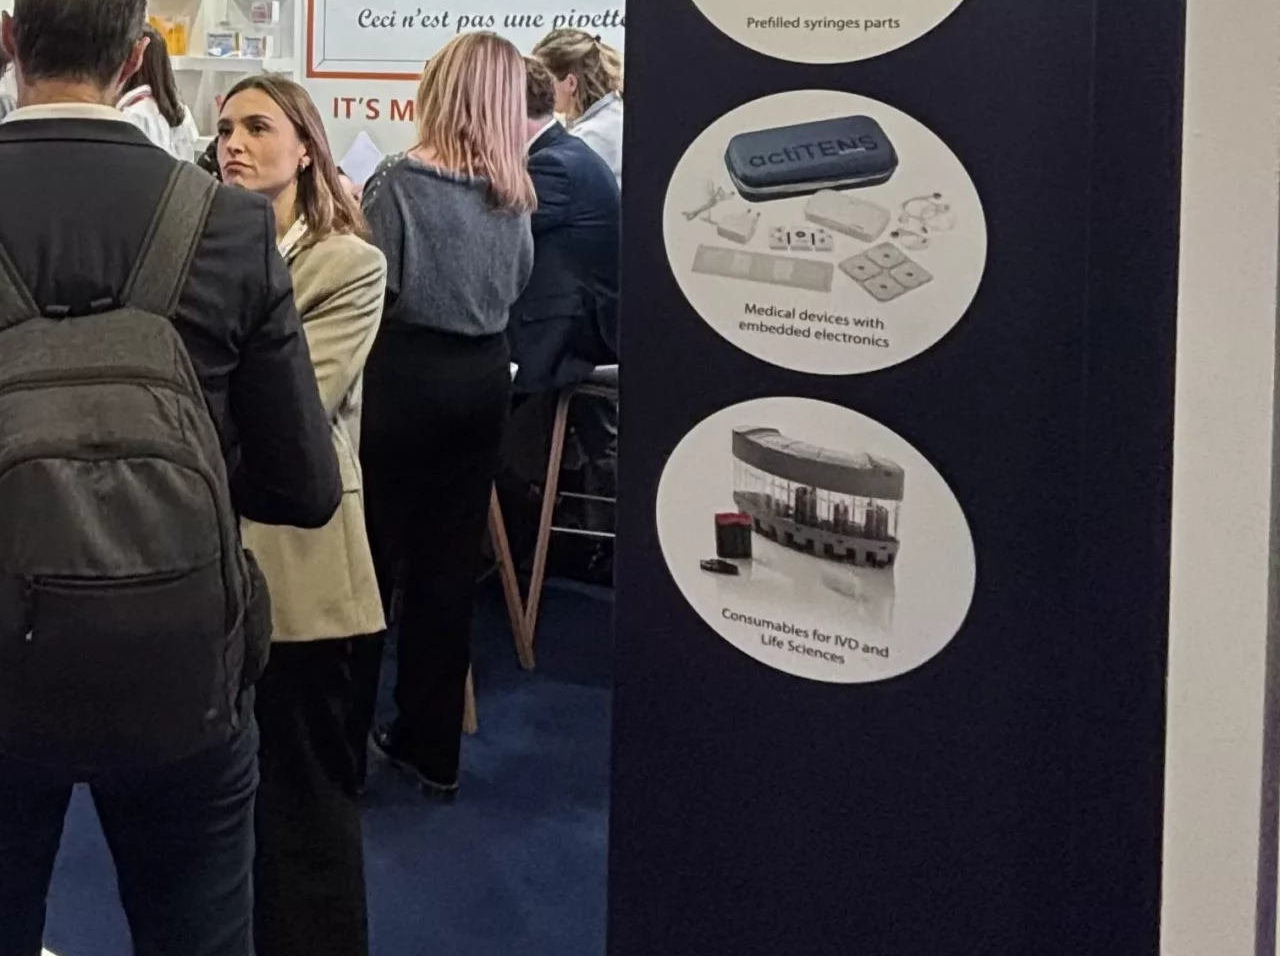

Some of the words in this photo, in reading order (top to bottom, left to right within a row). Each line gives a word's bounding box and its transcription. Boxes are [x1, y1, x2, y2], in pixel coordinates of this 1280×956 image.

[357, 8, 397, 28] Ceci
[456, 14, 495, 33] pas
[503, 14, 545, 28] une
[747, 16, 800, 29] Prefilled
[804, 16, 860, 31] syringes
[864, 17, 900, 32] parts
[748, 134, 879, 168] actiTENS
[744, 303, 796, 320] Medical
[799, 309, 850, 327] devices
[853, 317, 885, 330] with
[738, 320, 811, 338] embedded
[814, 328, 890, 348] electronics
[721, 607, 809, 638] Consumables
[812, 628, 832, 644] for
[834, 634, 859, 650] IVD
[861, 645, 889, 659] and
[761, 634, 784, 650] Life
[788, 640, 845, 665] Sciences
